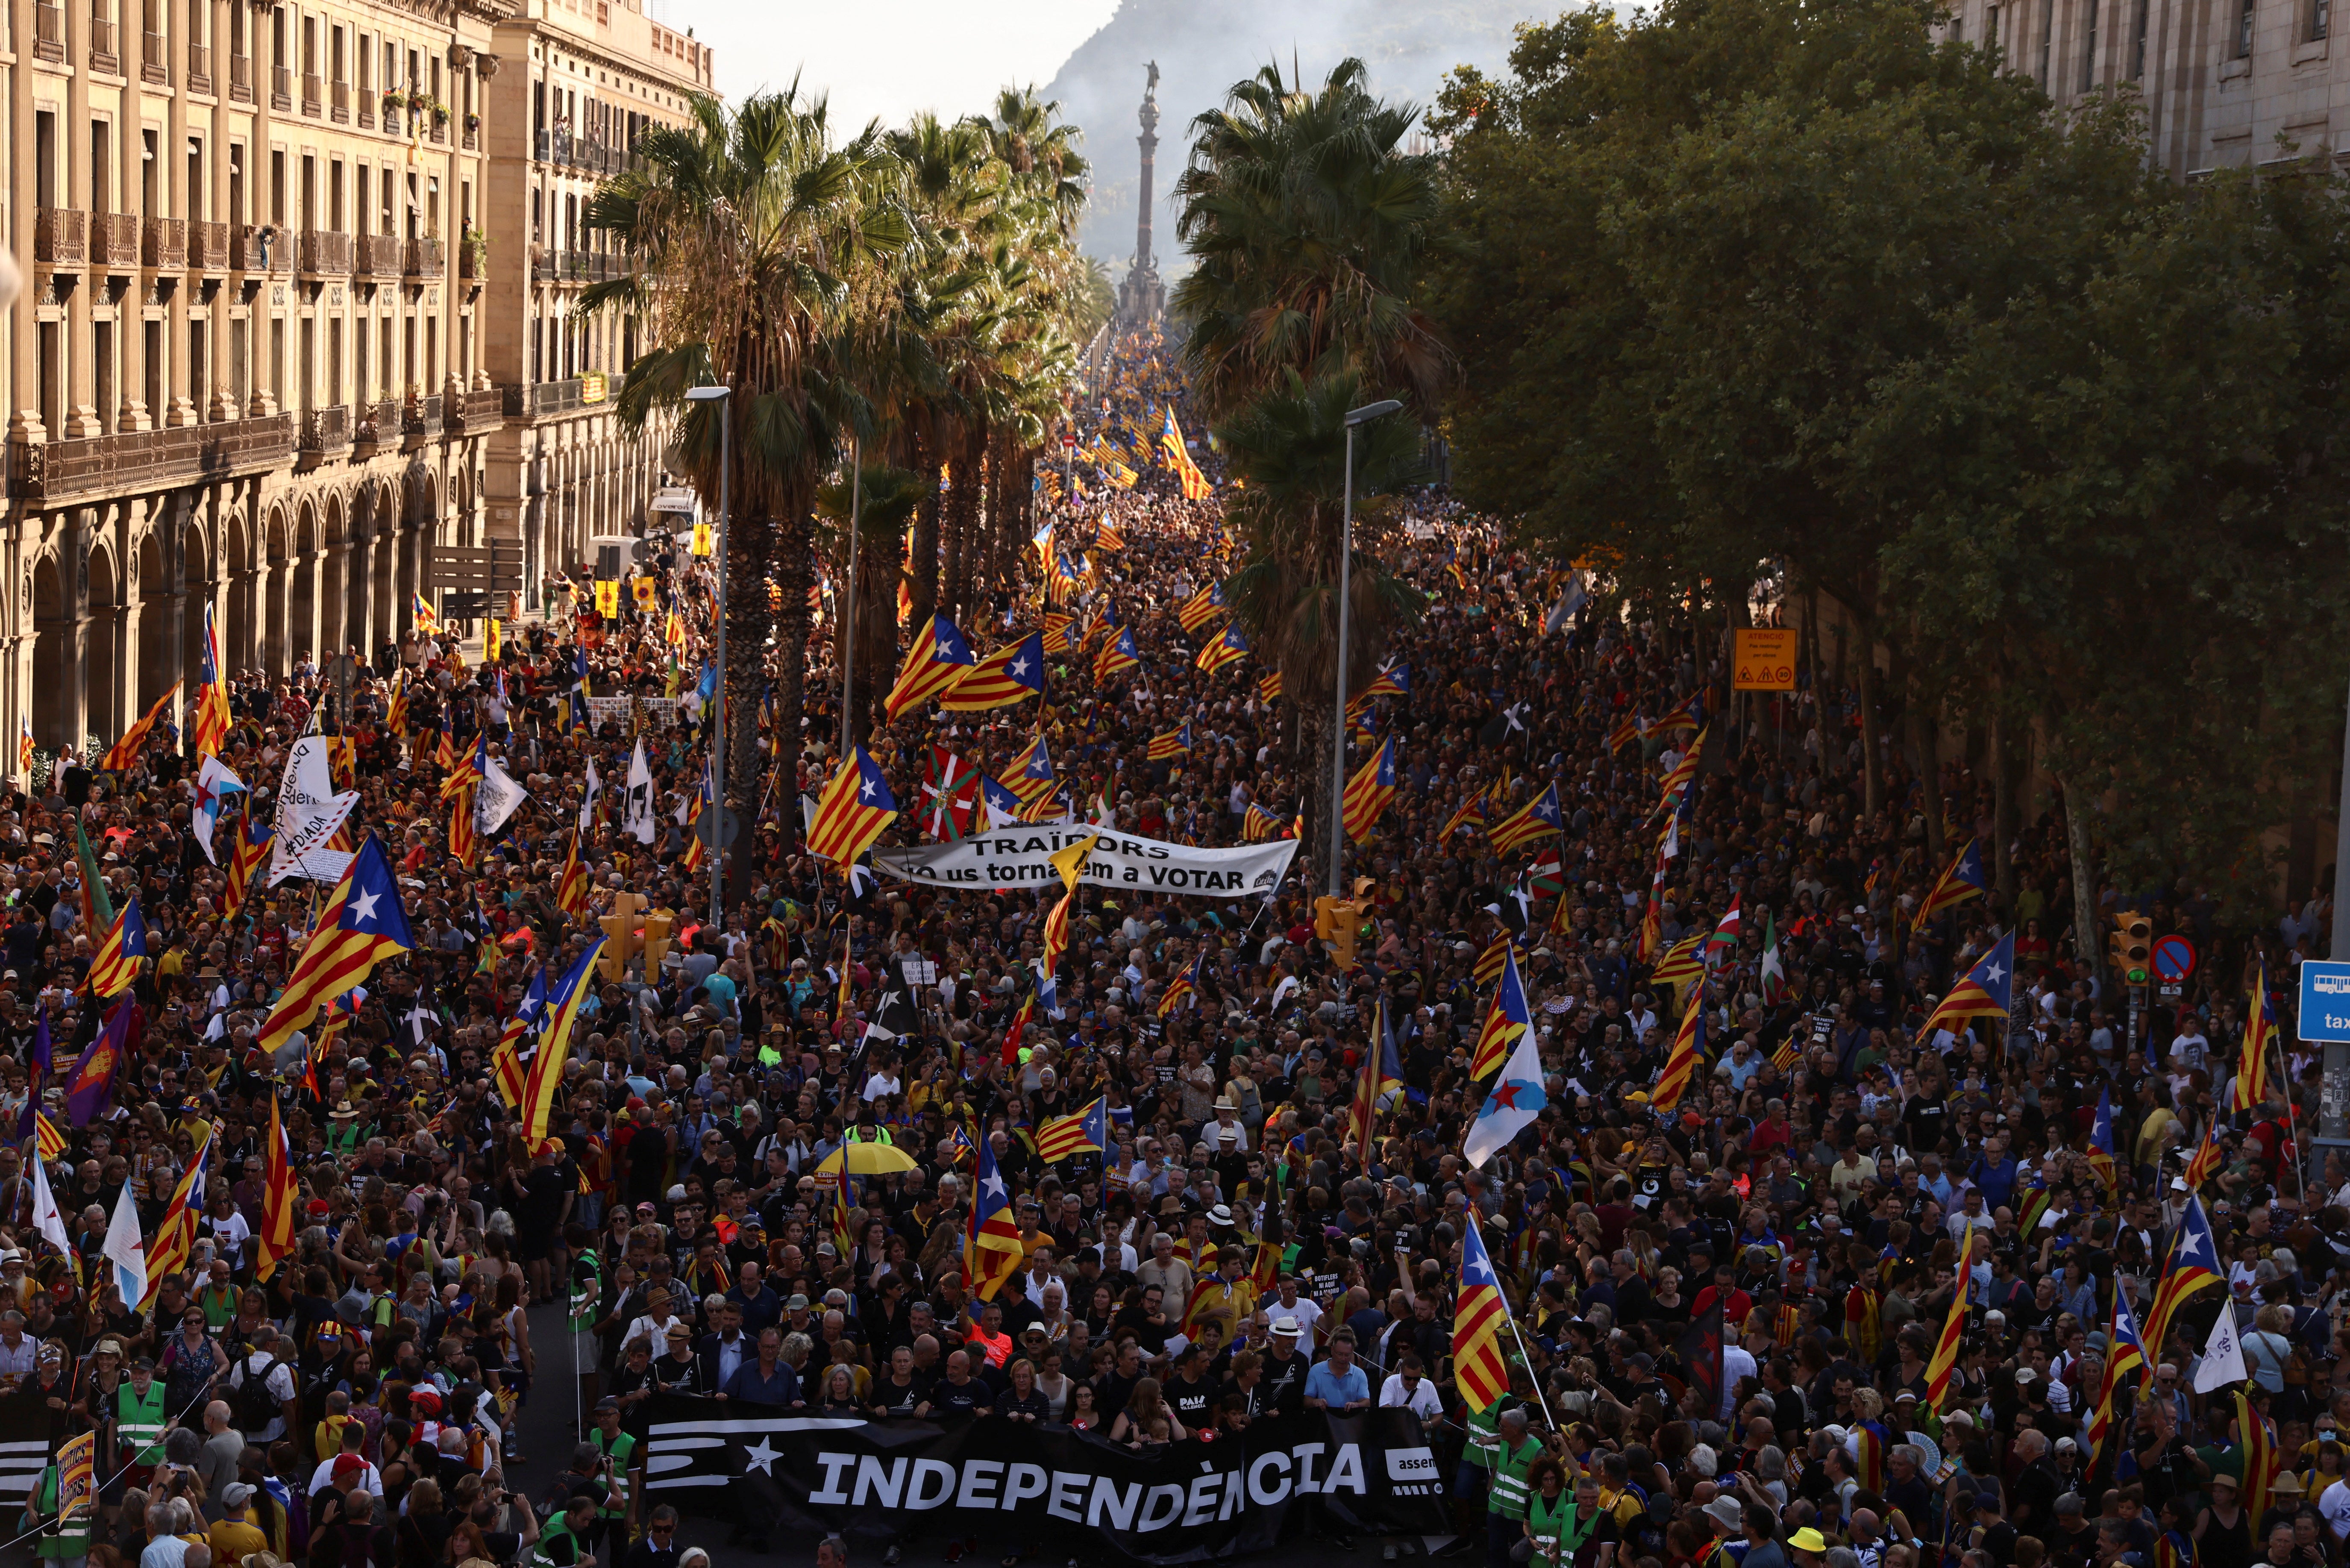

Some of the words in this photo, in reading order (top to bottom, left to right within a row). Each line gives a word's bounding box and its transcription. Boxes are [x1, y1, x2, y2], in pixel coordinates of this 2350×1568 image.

[946, 869, 978, 881] us
[986, 862, 1113, 883] tornaem
[1123, 866, 1138, 883] a
[1148, 865, 1244, 889] VOTAR
[1314, 1273, 1338, 1282] BOTIFLERS
[59, 1442, 87, 1477] POLÍTICS
[809, 1443, 1366, 1533] INDEPENDÈNCIA
